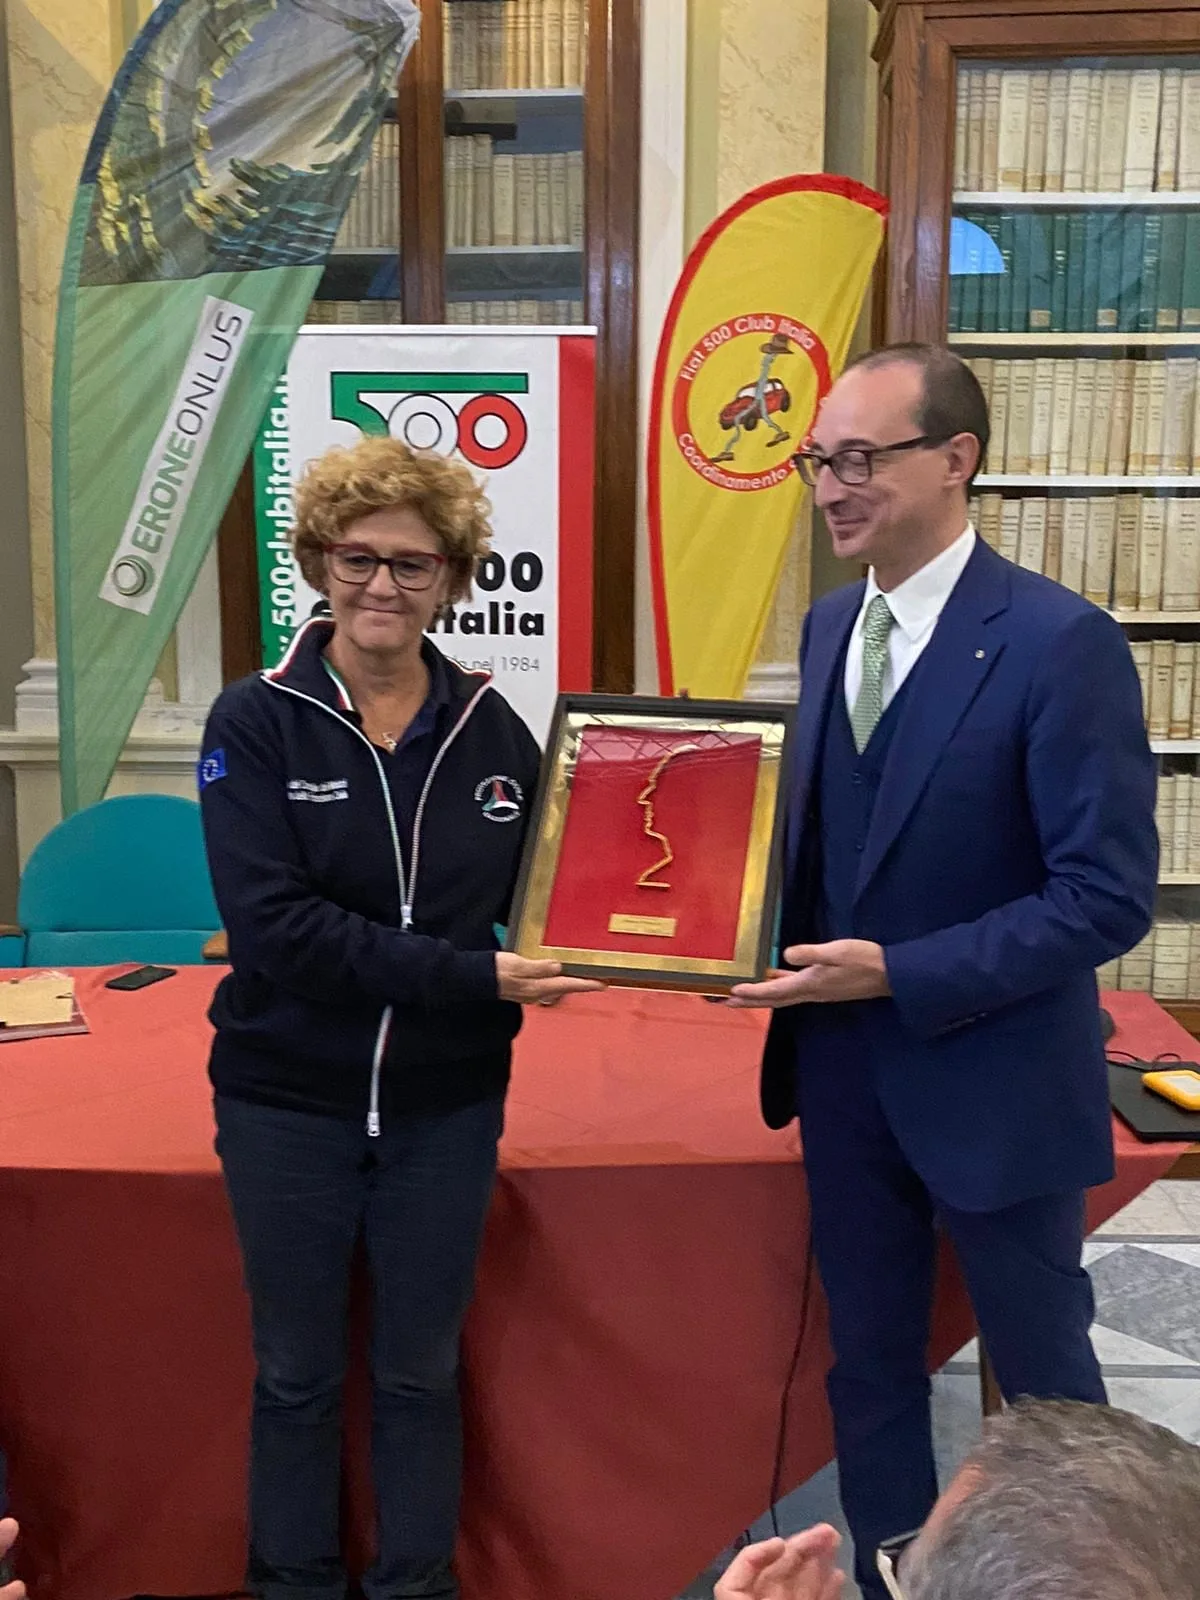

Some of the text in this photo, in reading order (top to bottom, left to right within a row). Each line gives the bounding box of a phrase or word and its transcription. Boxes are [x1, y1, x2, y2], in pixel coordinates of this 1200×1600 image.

[680, 316, 817, 381] Fiat 500 Club Italia
[131, 311, 242, 553] ERONEONLUS
[678, 433, 788, 489] Coordinamento
[474, 551, 543, 592] 00
[501, 656, 540, 672] 1984
